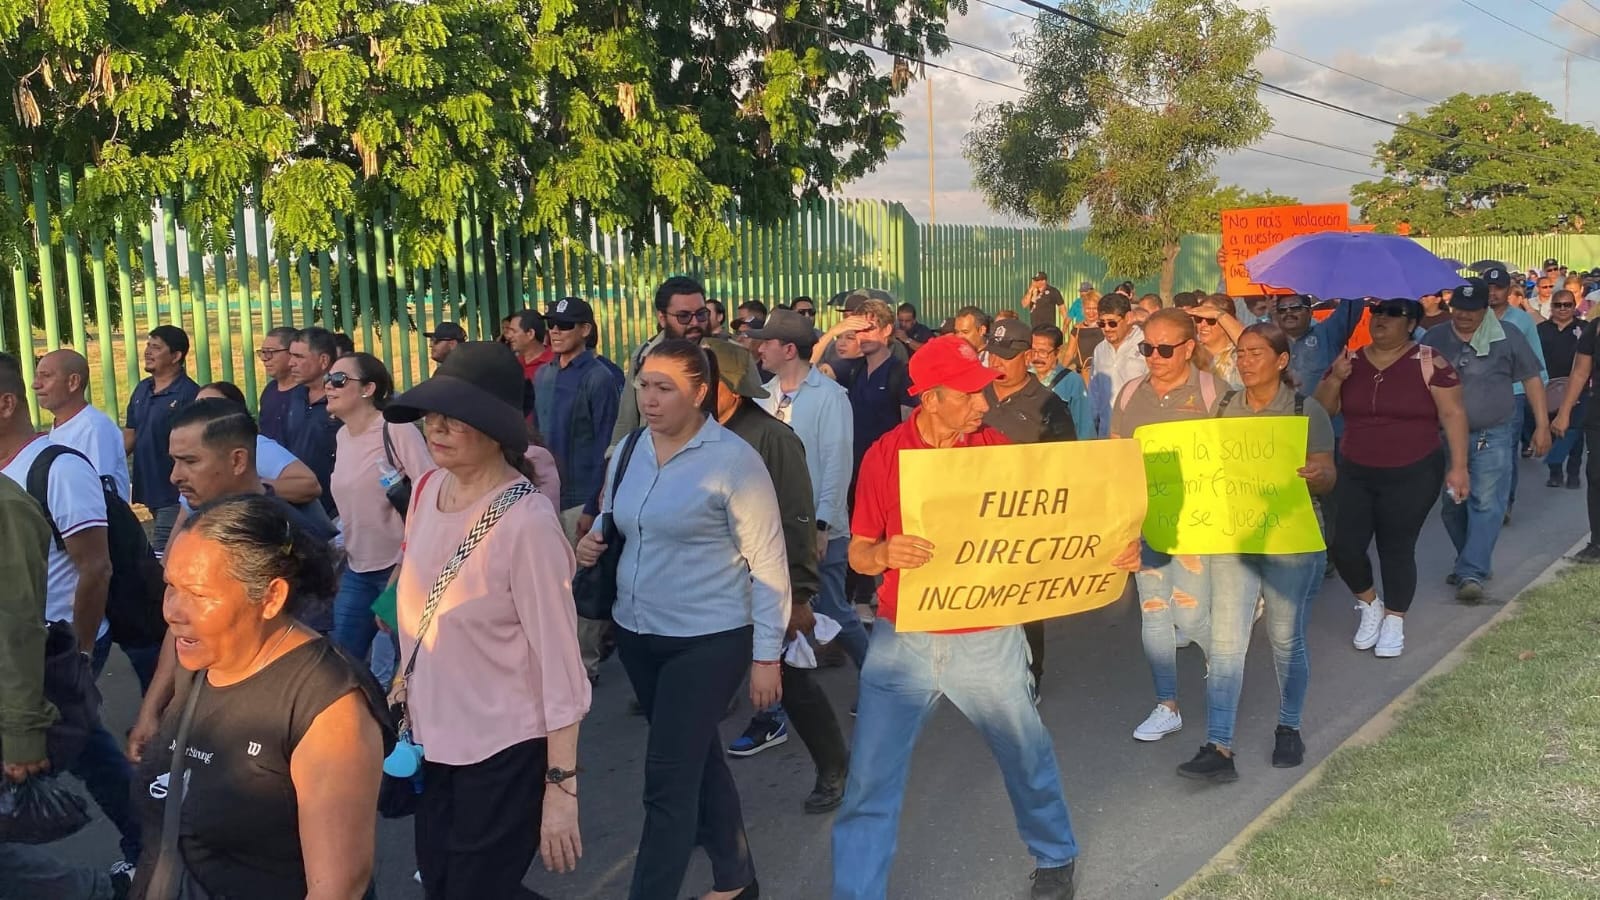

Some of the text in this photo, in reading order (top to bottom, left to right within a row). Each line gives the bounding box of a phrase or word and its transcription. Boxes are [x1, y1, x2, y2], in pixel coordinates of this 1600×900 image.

[1229, 213, 1248, 229] No
[1256, 211, 1282, 228] más
[1230, 235, 1238, 245] a
[1144, 425, 1275, 463] Con la salud
[1149, 476, 1170, 497] de
[1184, 473, 1203, 495] mi
[979, 488, 1069, 518] FUERA
[1158, 511, 1180, 527] no
[1189, 509, 1213, 527] se
[955, 534, 1101, 565] DIRECTOR
[918, 572, 1117, 612] INCOMPETENTE
